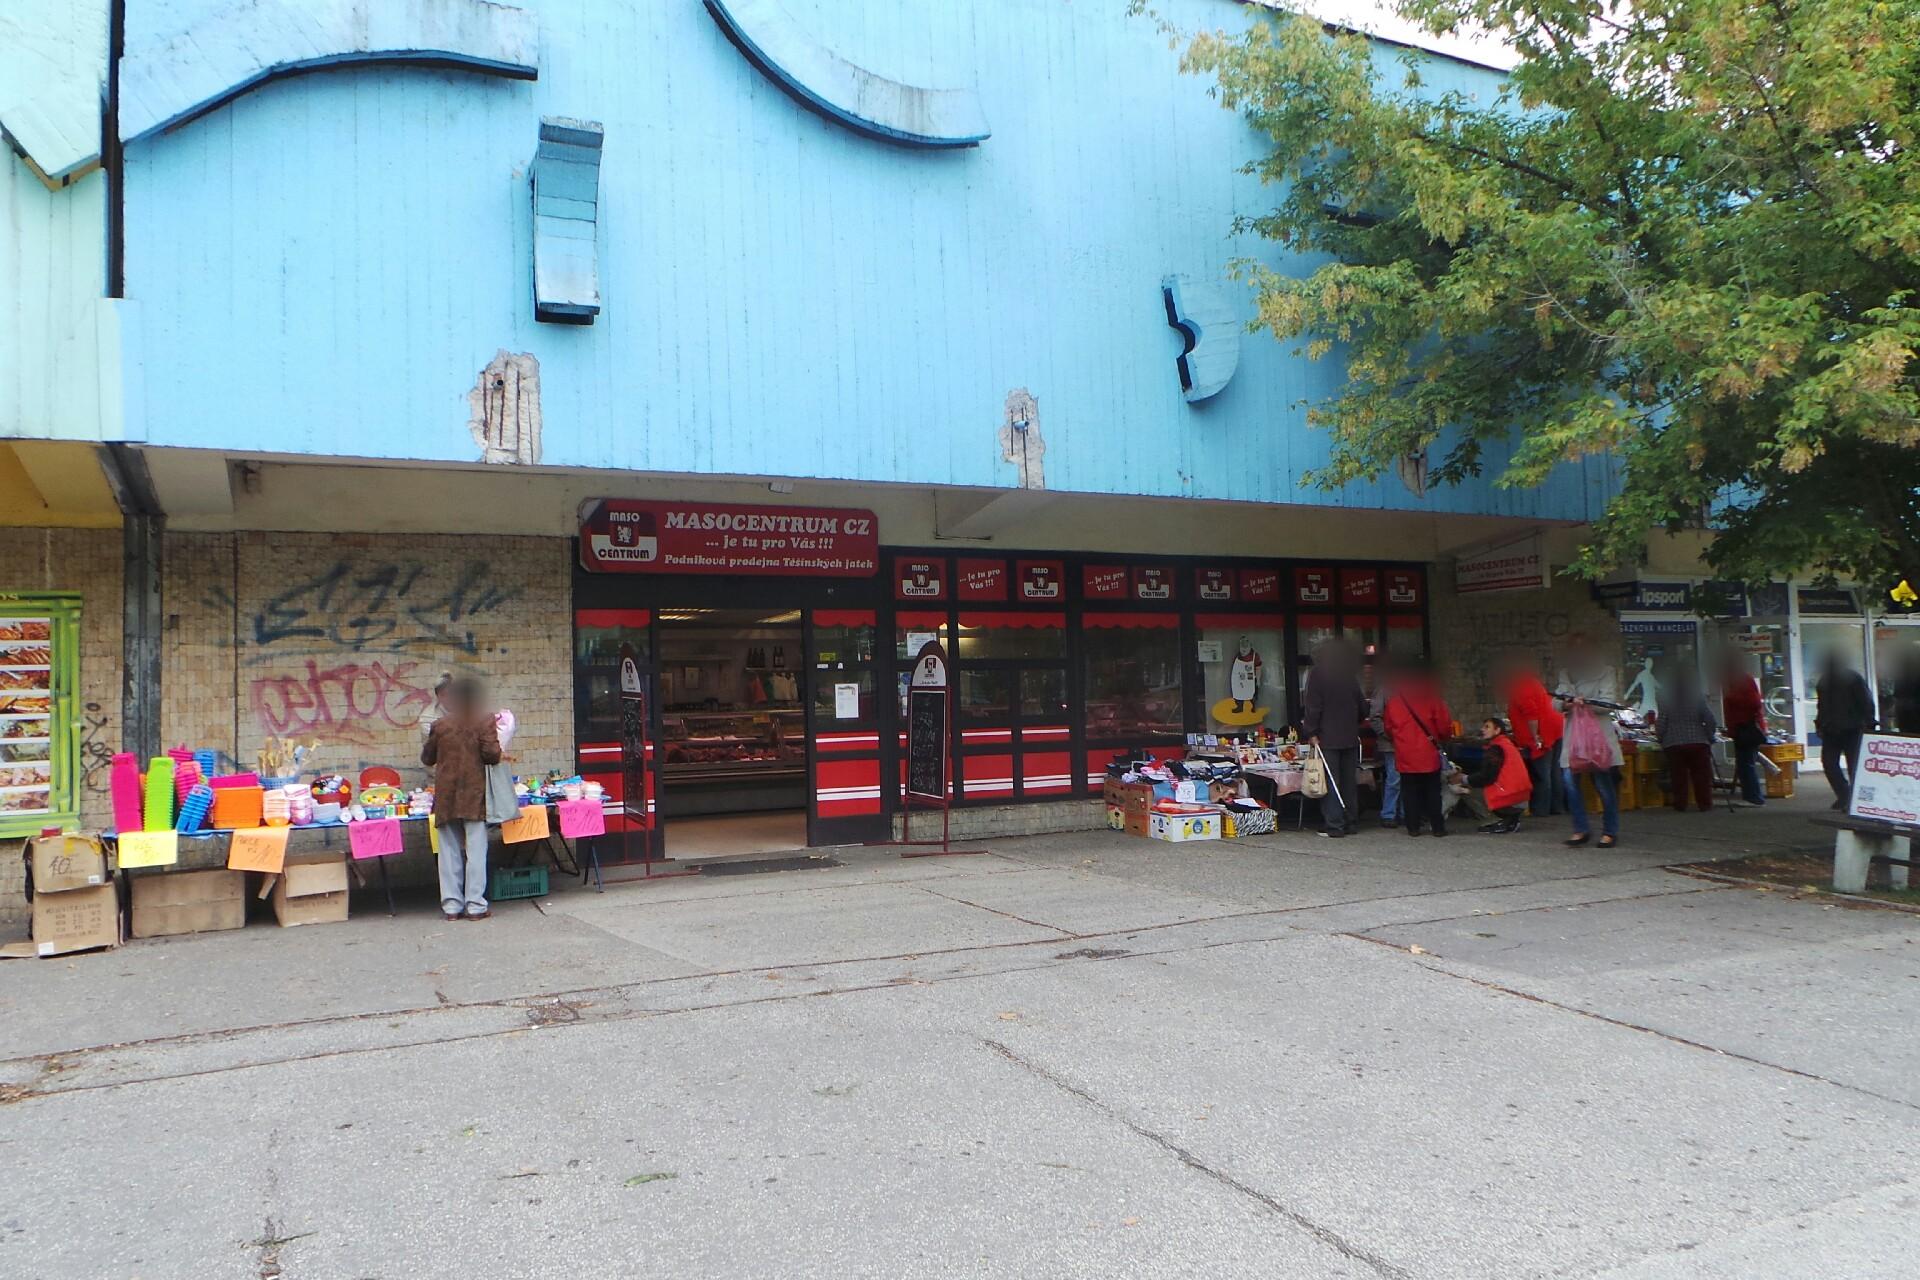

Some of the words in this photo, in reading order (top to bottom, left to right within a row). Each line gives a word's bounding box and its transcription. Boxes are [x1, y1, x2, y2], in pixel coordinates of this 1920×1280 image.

[610, 512, 640, 522] MASO
[664, 511, 838, 534] MASOCENTRUM
[844, 518, 871, 536] CZ
[723, 534, 738, 550] je
[742, 536, 758, 548] tu
[761, 538, 786, 551] pro
[790, 536, 816, 549] Vás
[598, 548, 650, 560] CENTRUM
[664, 553, 726, 566] Podniková
[729, 556, 780, 569] prodejna
[1635, 588, 1685, 607] ipsport
